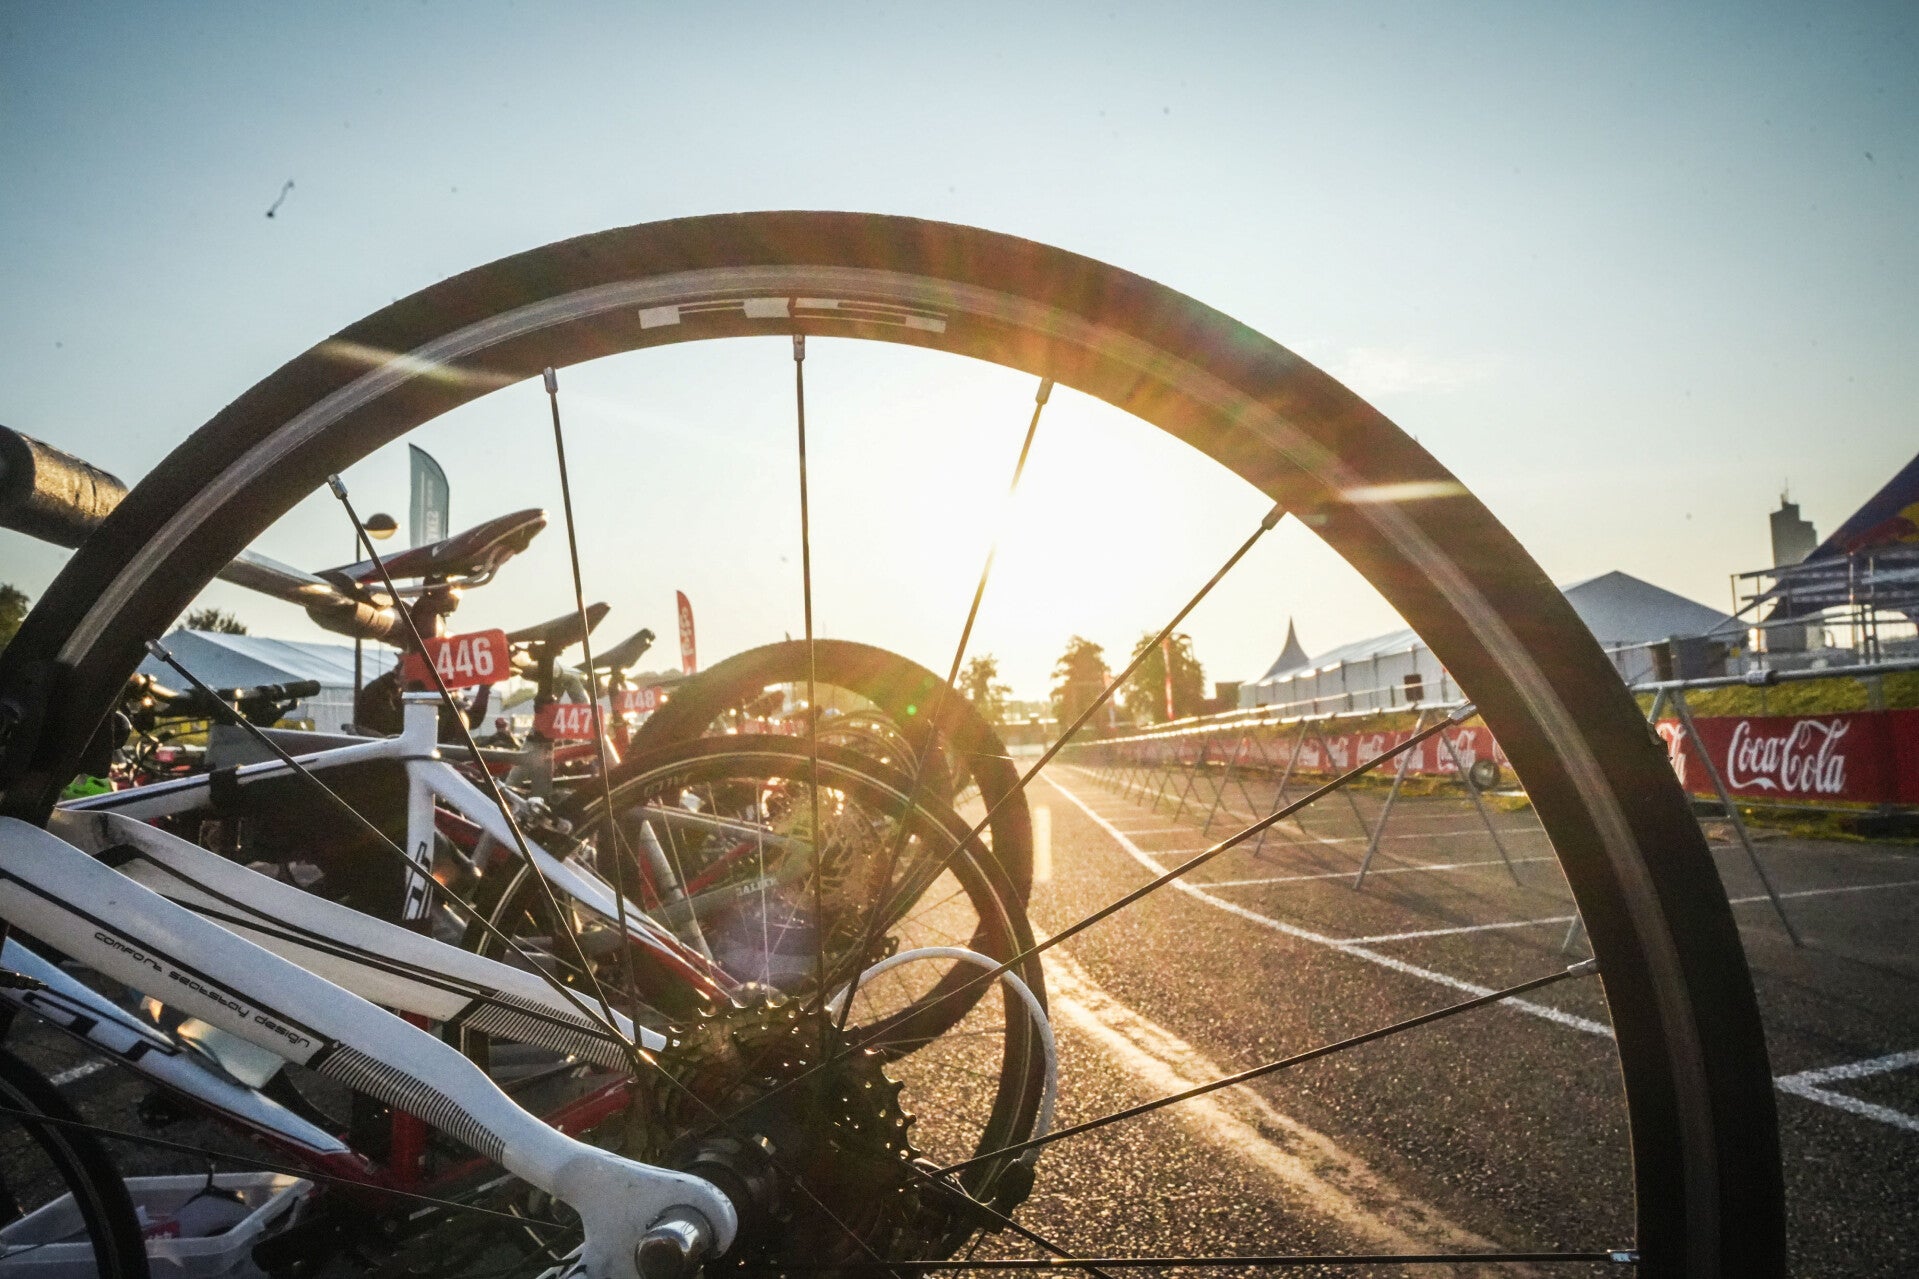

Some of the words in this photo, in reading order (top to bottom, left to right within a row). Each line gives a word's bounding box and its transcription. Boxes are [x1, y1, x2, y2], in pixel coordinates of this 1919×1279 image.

[437, 636, 494, 680] 446
[553, 707, 593, 734] 447
[624, 689, 655, 709] 448
[1727, 719, 1850, 793] Coca-Cola
[168, 970, 250, 1018] seatstay
[254, 1014, 310, 1048] design
